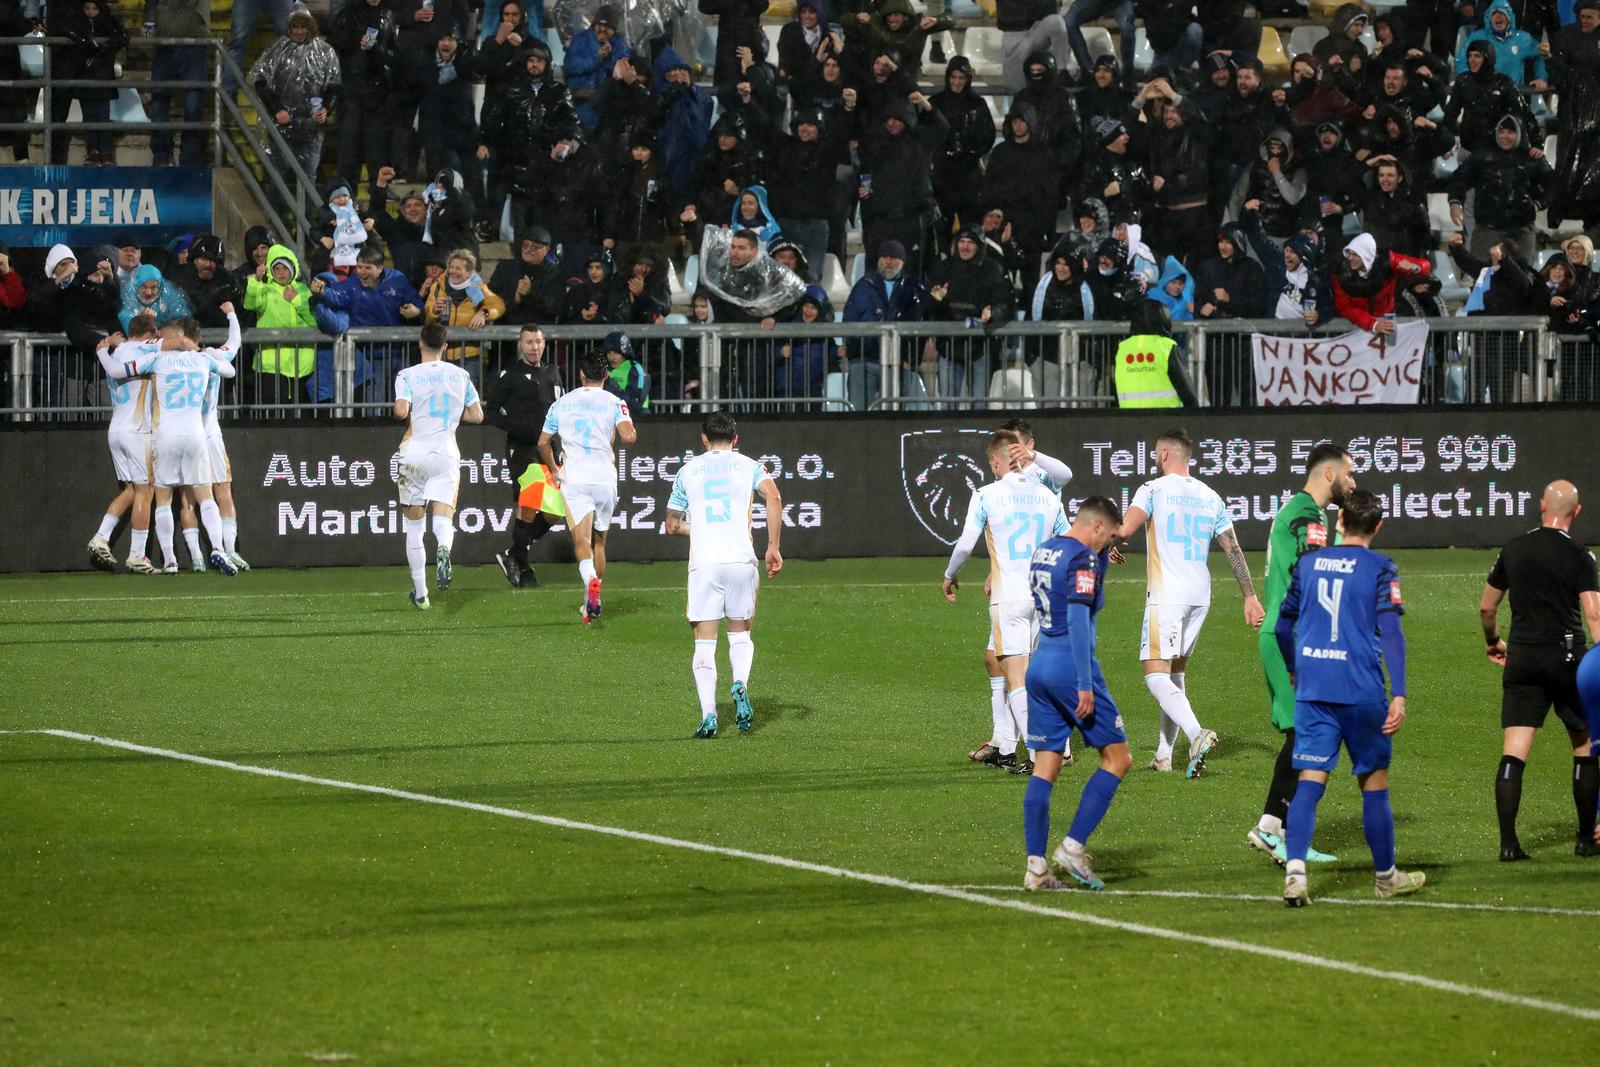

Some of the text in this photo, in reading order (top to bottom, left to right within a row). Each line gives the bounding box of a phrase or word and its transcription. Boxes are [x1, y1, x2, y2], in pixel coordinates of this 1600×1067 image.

[0, 188, 160, 225] K RIJEKA
[1260, 332, 1388, 367] NIKO 4
[164, 372, 206, 410] 28
[1259, 348, 1421, 398] JANKOVIĆ
[428, 392, 450, 431] 4
[263, 453, 376, 487] Auto
[1188, 437, 1279, 476] 385
[1346, 435, 1427, 474] 665
[1437, 434, 1517, 473] 990
[704, 478, 732, 523] 5
[1004, 511, 1046, 561] 21
[1166, 511, 1214, 561] 45
[1313, 557, 1358, 574] KOVAČIĆ
[1317, 577, 1345, 643] 4
